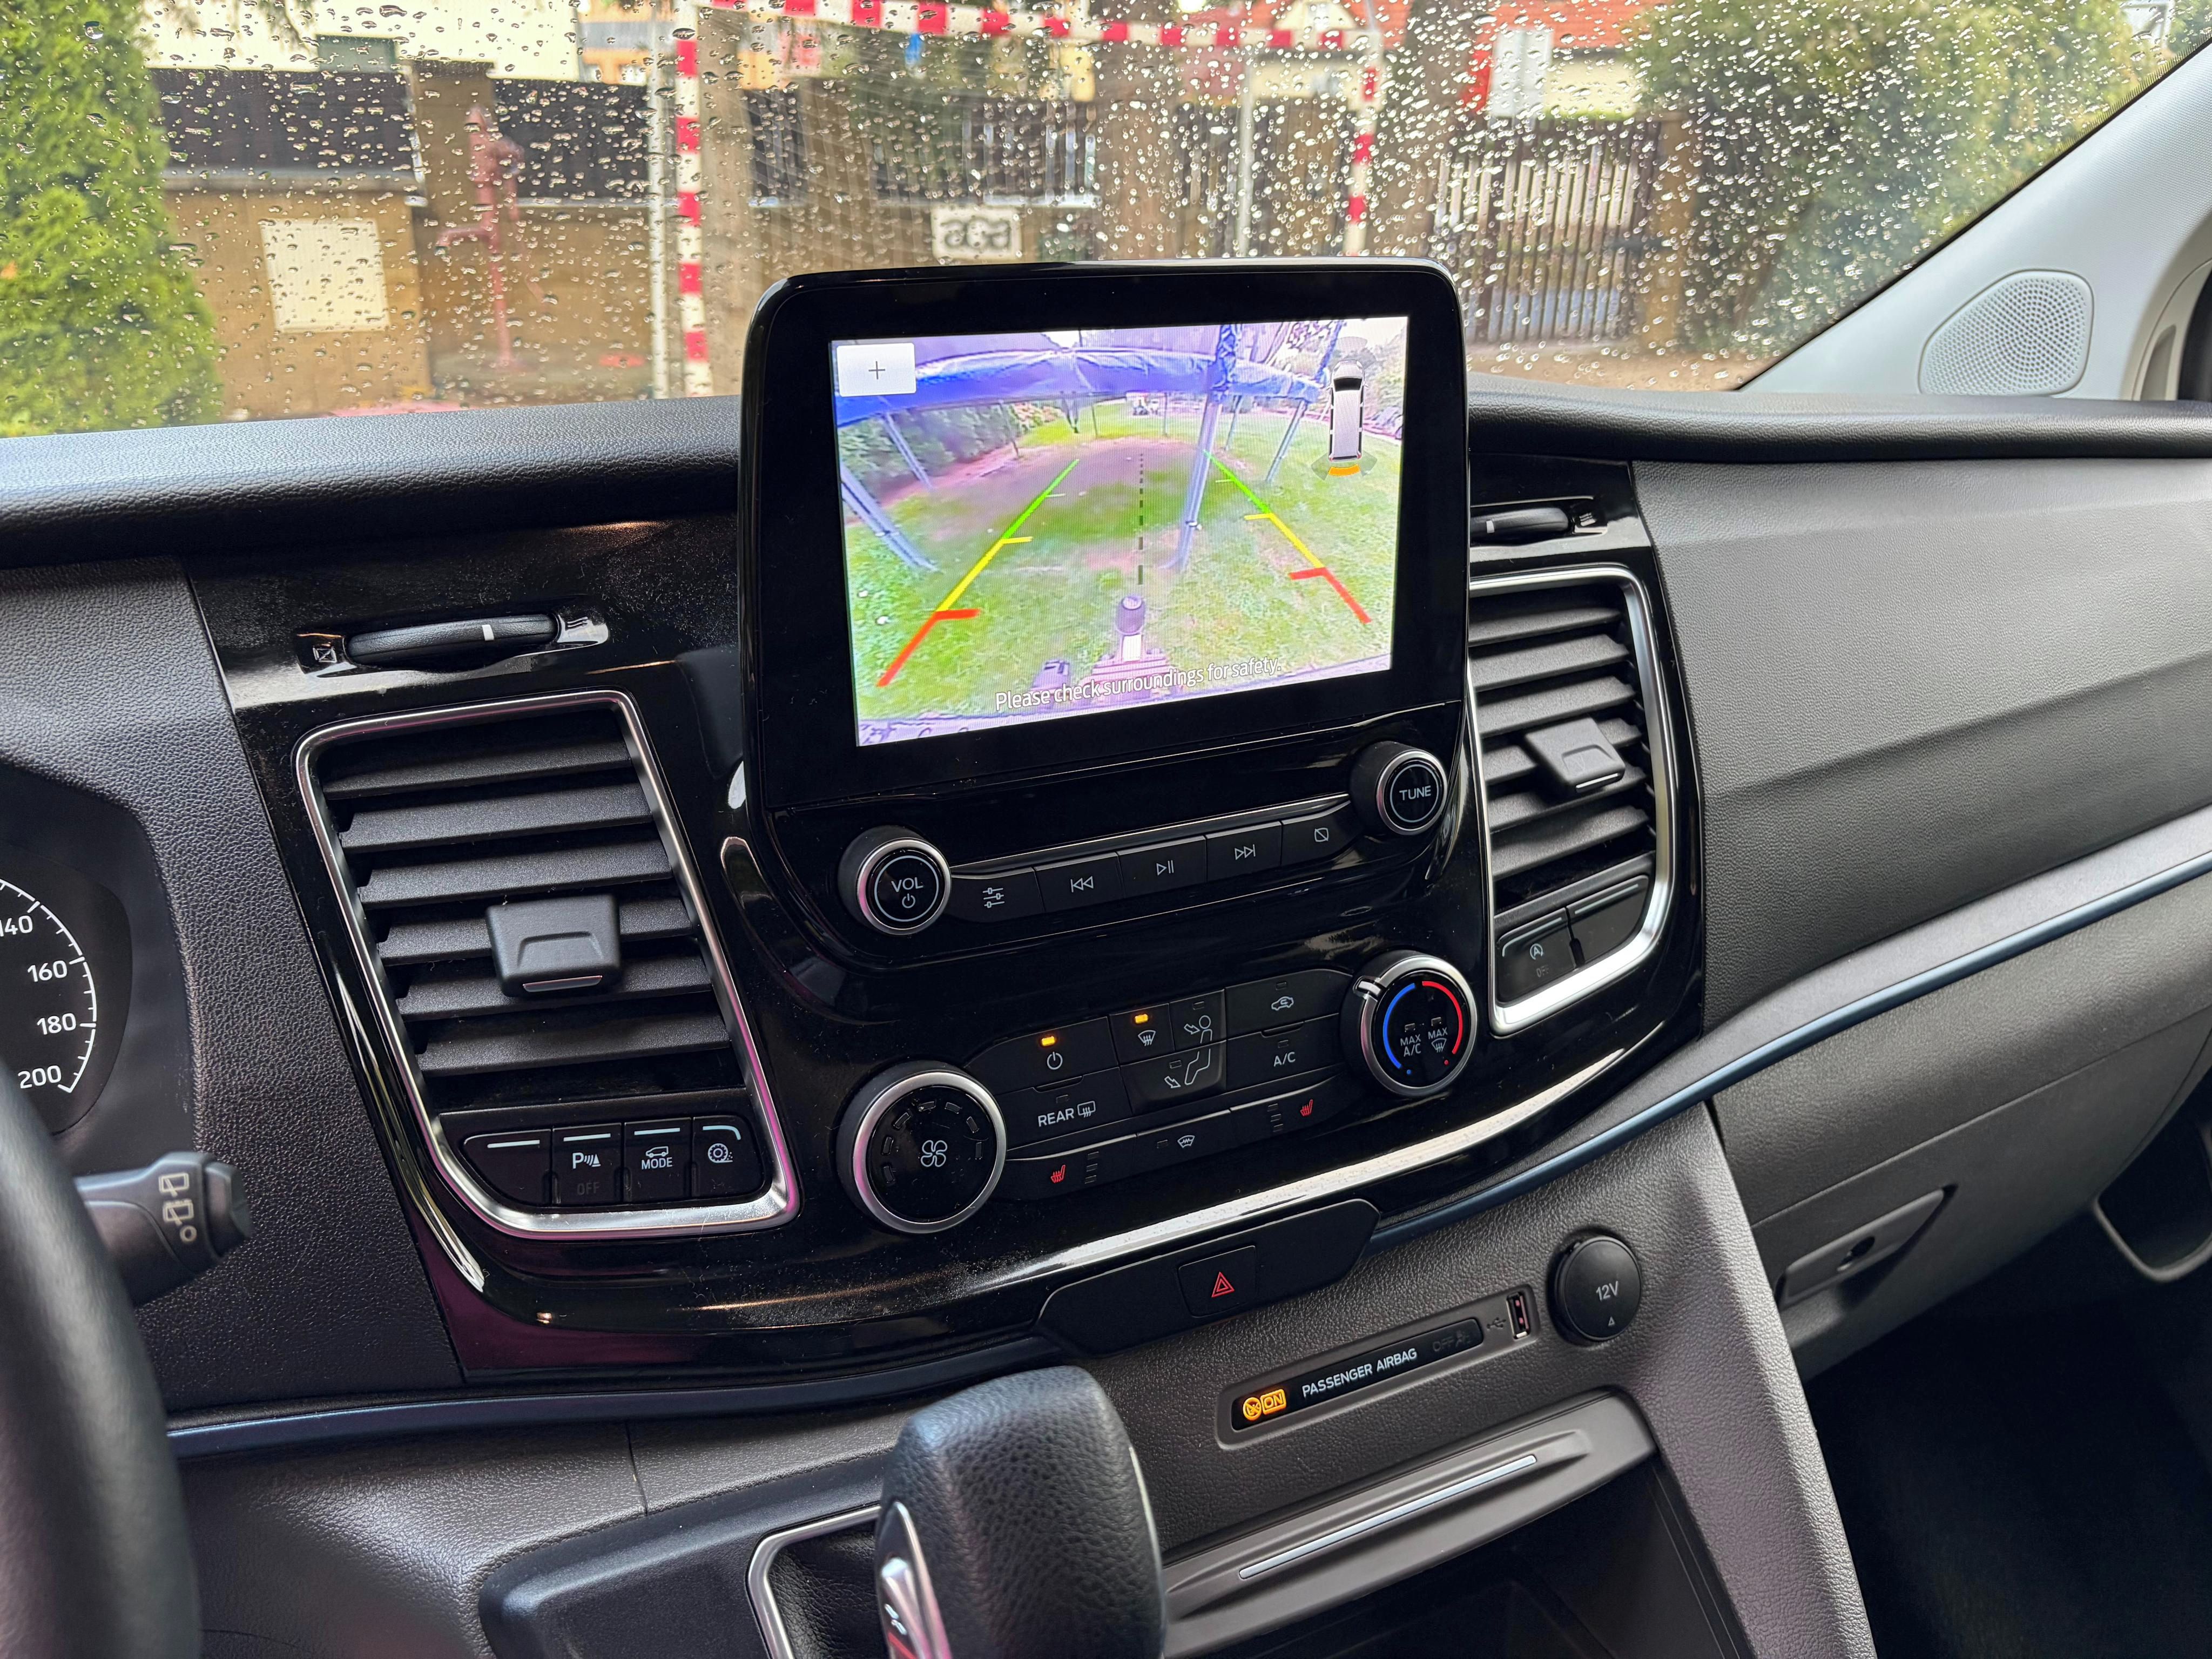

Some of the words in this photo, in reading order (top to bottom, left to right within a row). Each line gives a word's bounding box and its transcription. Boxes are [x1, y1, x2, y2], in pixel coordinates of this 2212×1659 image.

[995, 691, 1050, 711] Please
[1054, 679, 1100, 702] check
[1103, 667, 1204, 696] surroundings
[1208, 663, 1229, 682] for
[1231, 656, 1282, 678] safety.
[1399, 785, 1431, 801] TUNE
[891, 876, 923, 893] VOL
[27, 960, 68, 982] 160
[36, 1013, 77, 1035] 180
[1400, 1034, 1421, 1047] MAX
[1427, 1027, 1448, 1040] MAX
[1404, 1043, 1421, 1057] A/C
[1273, 1051, 1296, 1067] A/C
[17, 1065, 62, 1089] 200
[1037, 1108, 1075, 1128] REAR
[641, 1157, 673, 1170] MODE
[576, 1181, 600, 1196] OFF
[1595, 1280, 1618, 1302] 12V
[1264, 1393, 1283, 1409] ON
[1301, 1363, 1373, 1398] PASSENGER
[1376, 1347, 1418, 1372] AIRBAG
